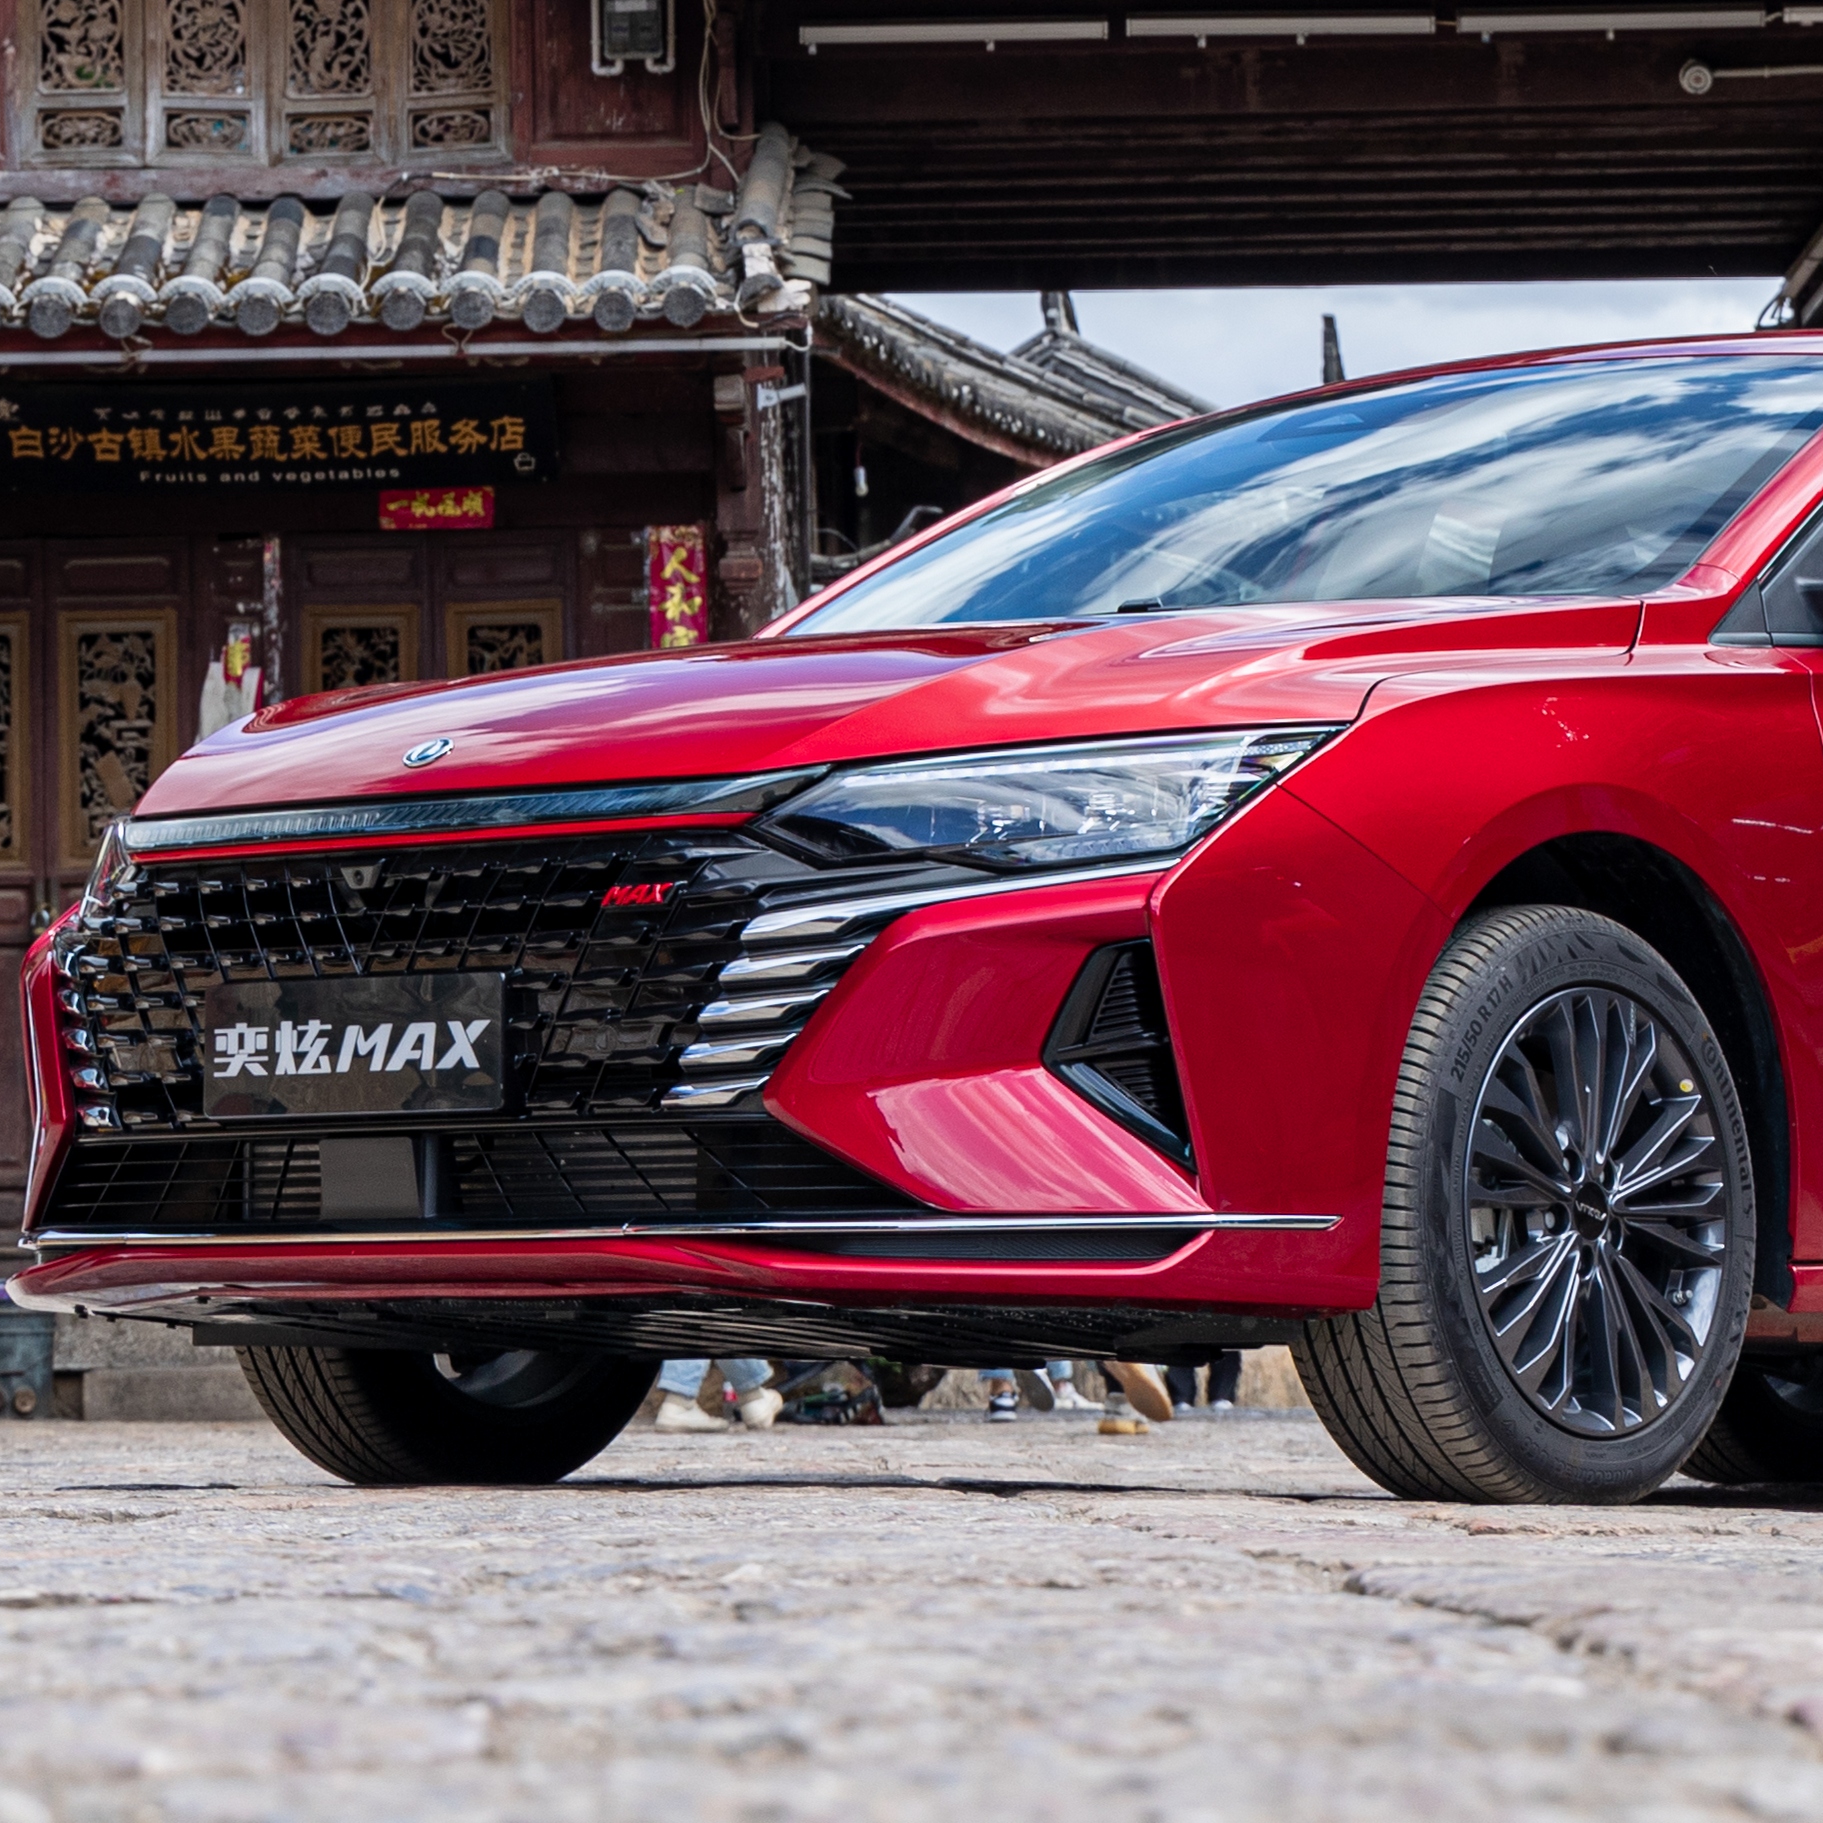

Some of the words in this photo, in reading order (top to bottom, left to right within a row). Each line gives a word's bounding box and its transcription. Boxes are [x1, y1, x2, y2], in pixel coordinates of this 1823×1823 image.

[8, 415, 527, 463] 白沙古镇水果蔬菜便民服务店
[139, 470, 208, 483] Fruits
[220, 470, 261, 483] and
[272, 467, 401, 484] vegetables
[601, 882, 674, 908] MAX
[213, 1019, 492, 1078] 奕炫MAX
[1450, 1018, 1484, 1084] 215/50
[1477, 1005, 1493, 1023] R
[1498, 974, 1514, 995] H
[1700, 1036, 1753, 1192] Continental
